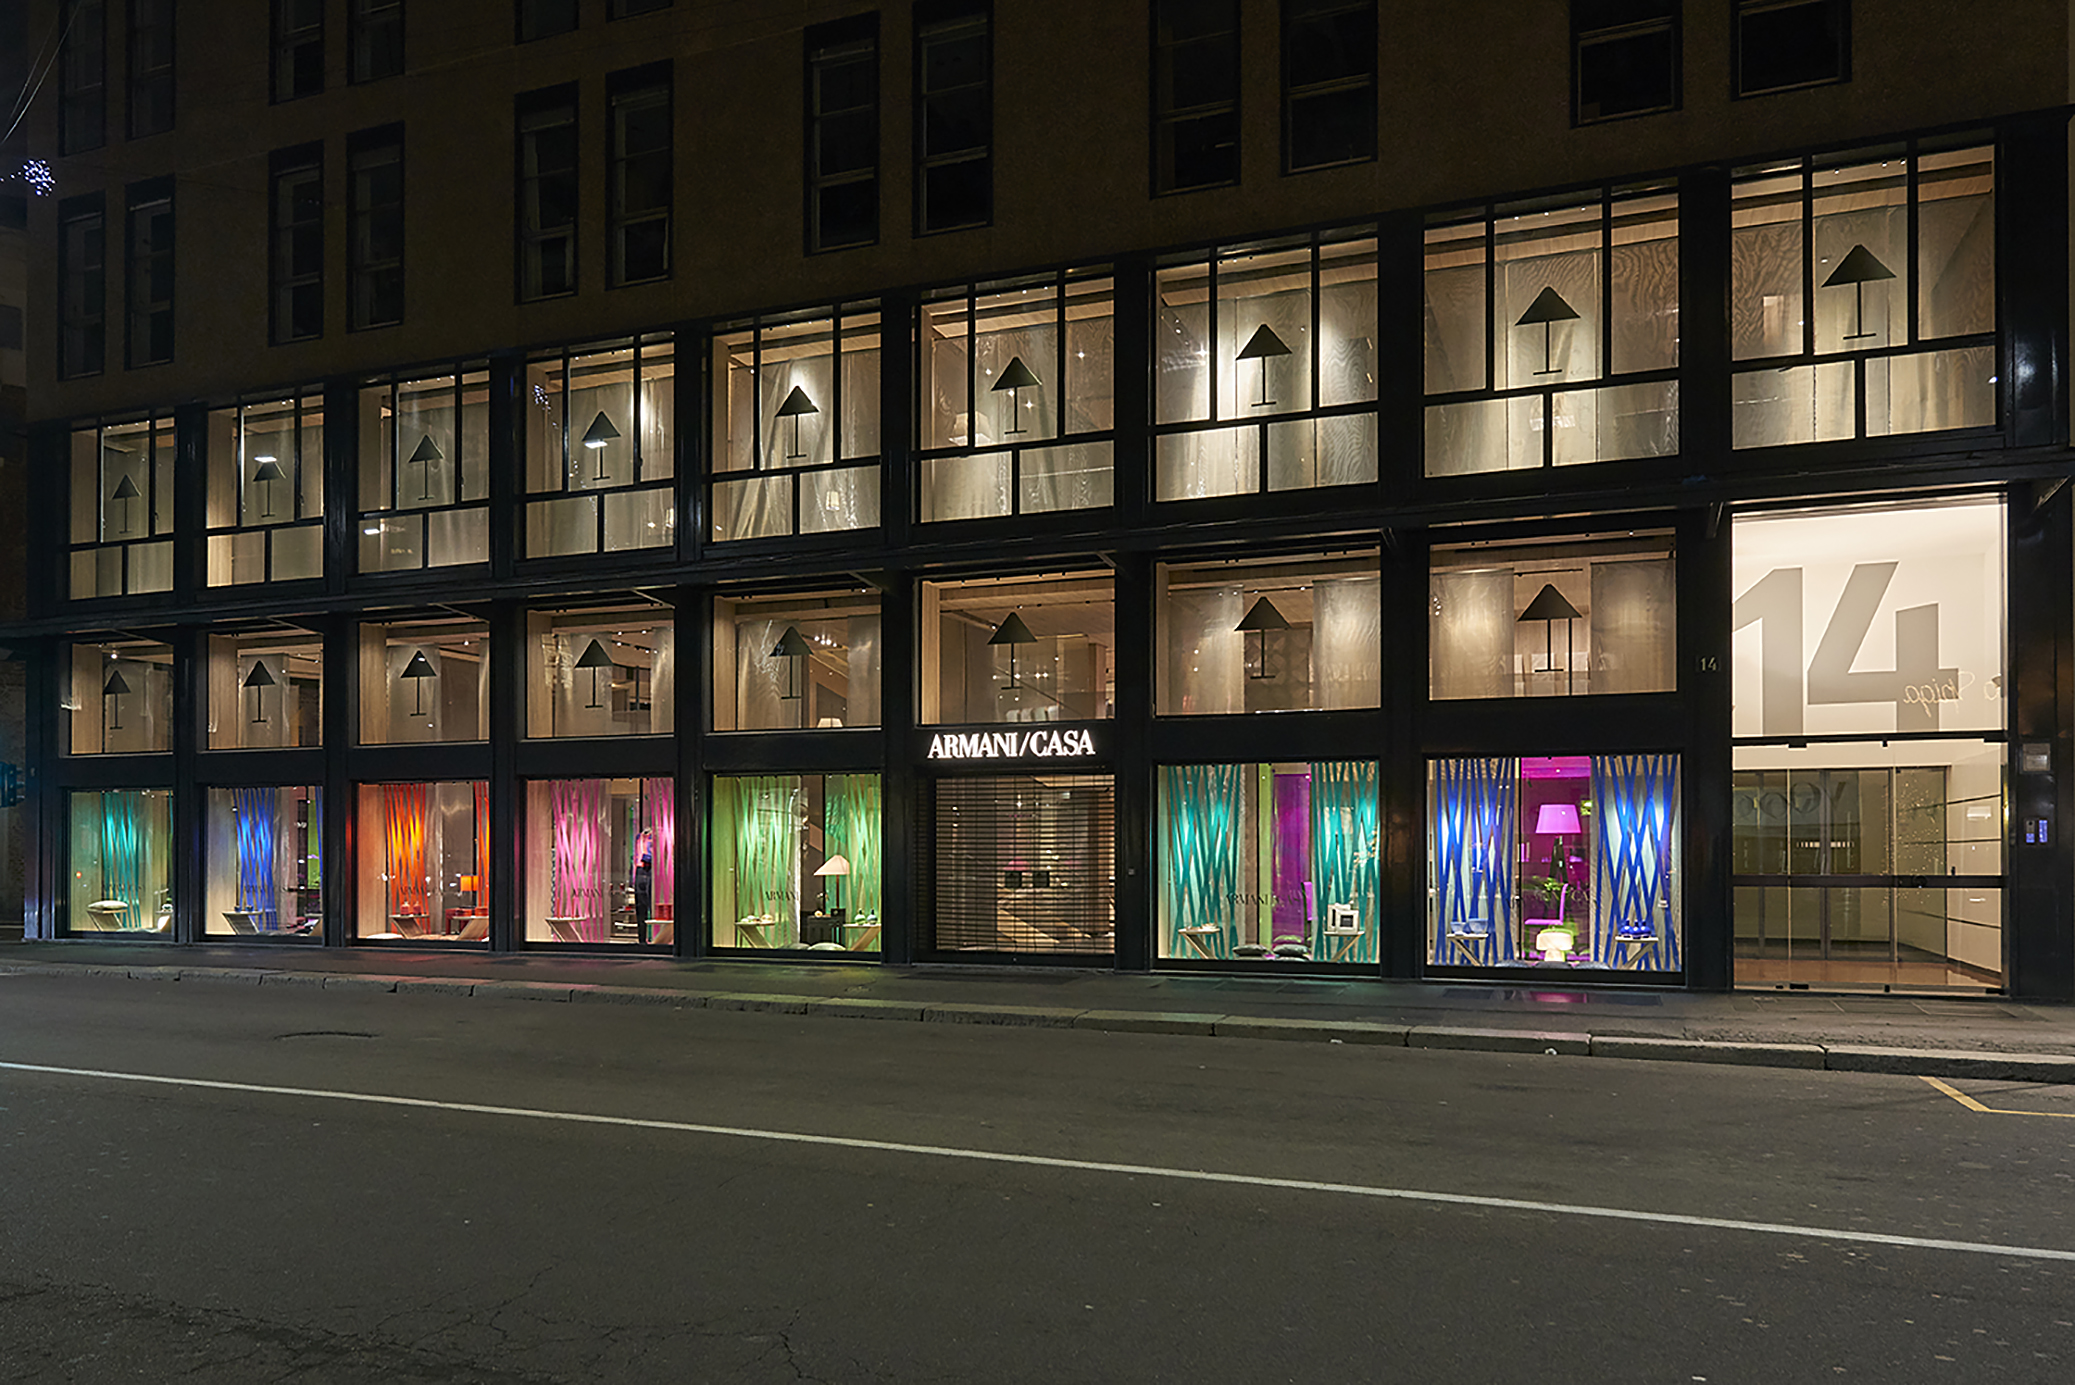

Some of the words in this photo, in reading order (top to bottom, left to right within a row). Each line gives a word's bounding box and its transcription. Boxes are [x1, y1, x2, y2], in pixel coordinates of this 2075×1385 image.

[1733, 561, 1959, 735] 14
[1700, 656, 1717, 671] 14
[927, 729, 1096, 759] ARMANI/CASA
